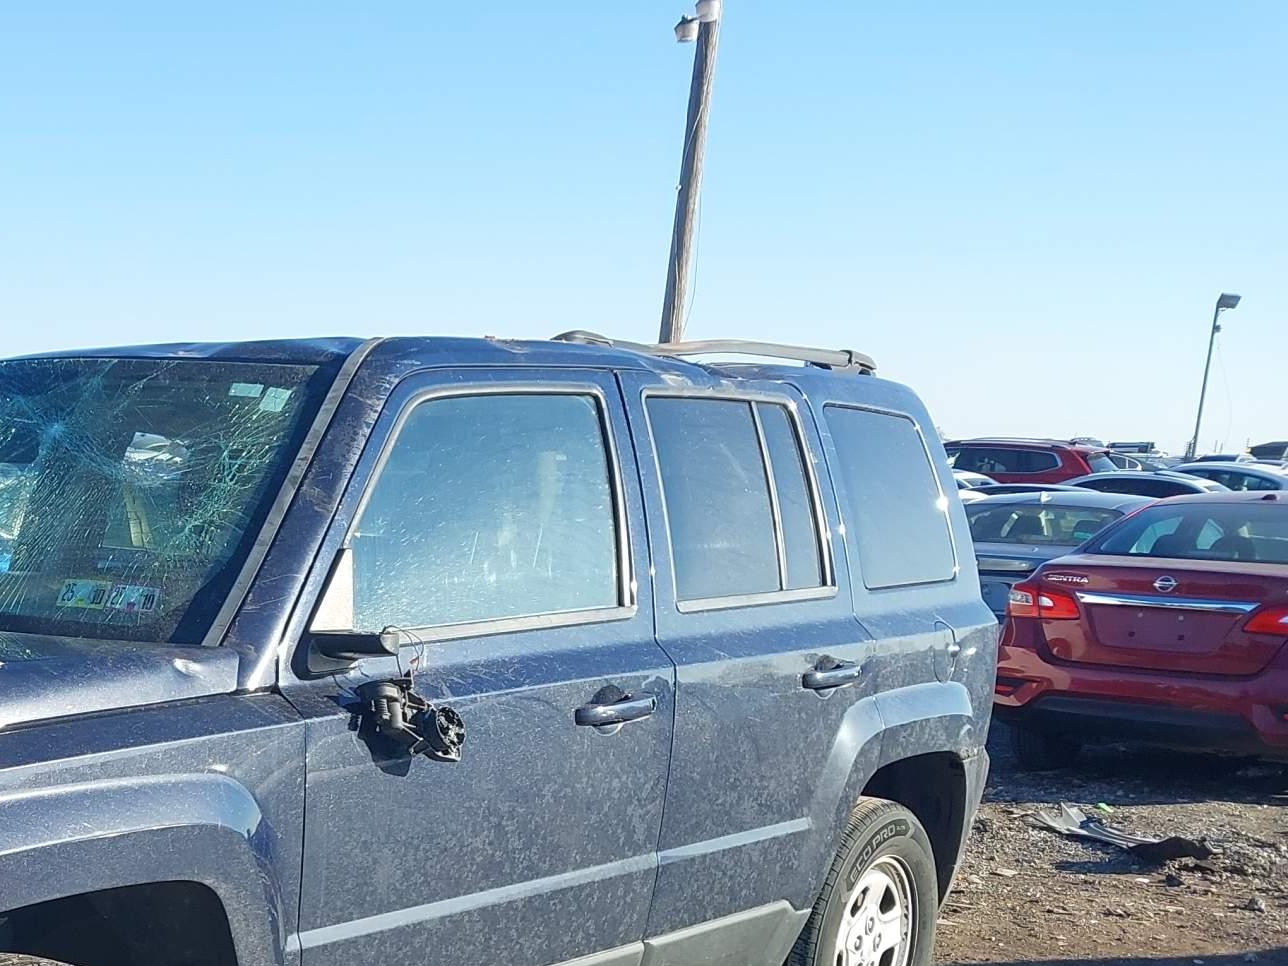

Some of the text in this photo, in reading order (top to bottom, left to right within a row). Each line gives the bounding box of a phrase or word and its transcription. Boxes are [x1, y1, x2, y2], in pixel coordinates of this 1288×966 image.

[1047, 574, 1089, 583] SENTRA
[850, 846, 872, 884] ECO
[872, 824, 896, 849] PRO
